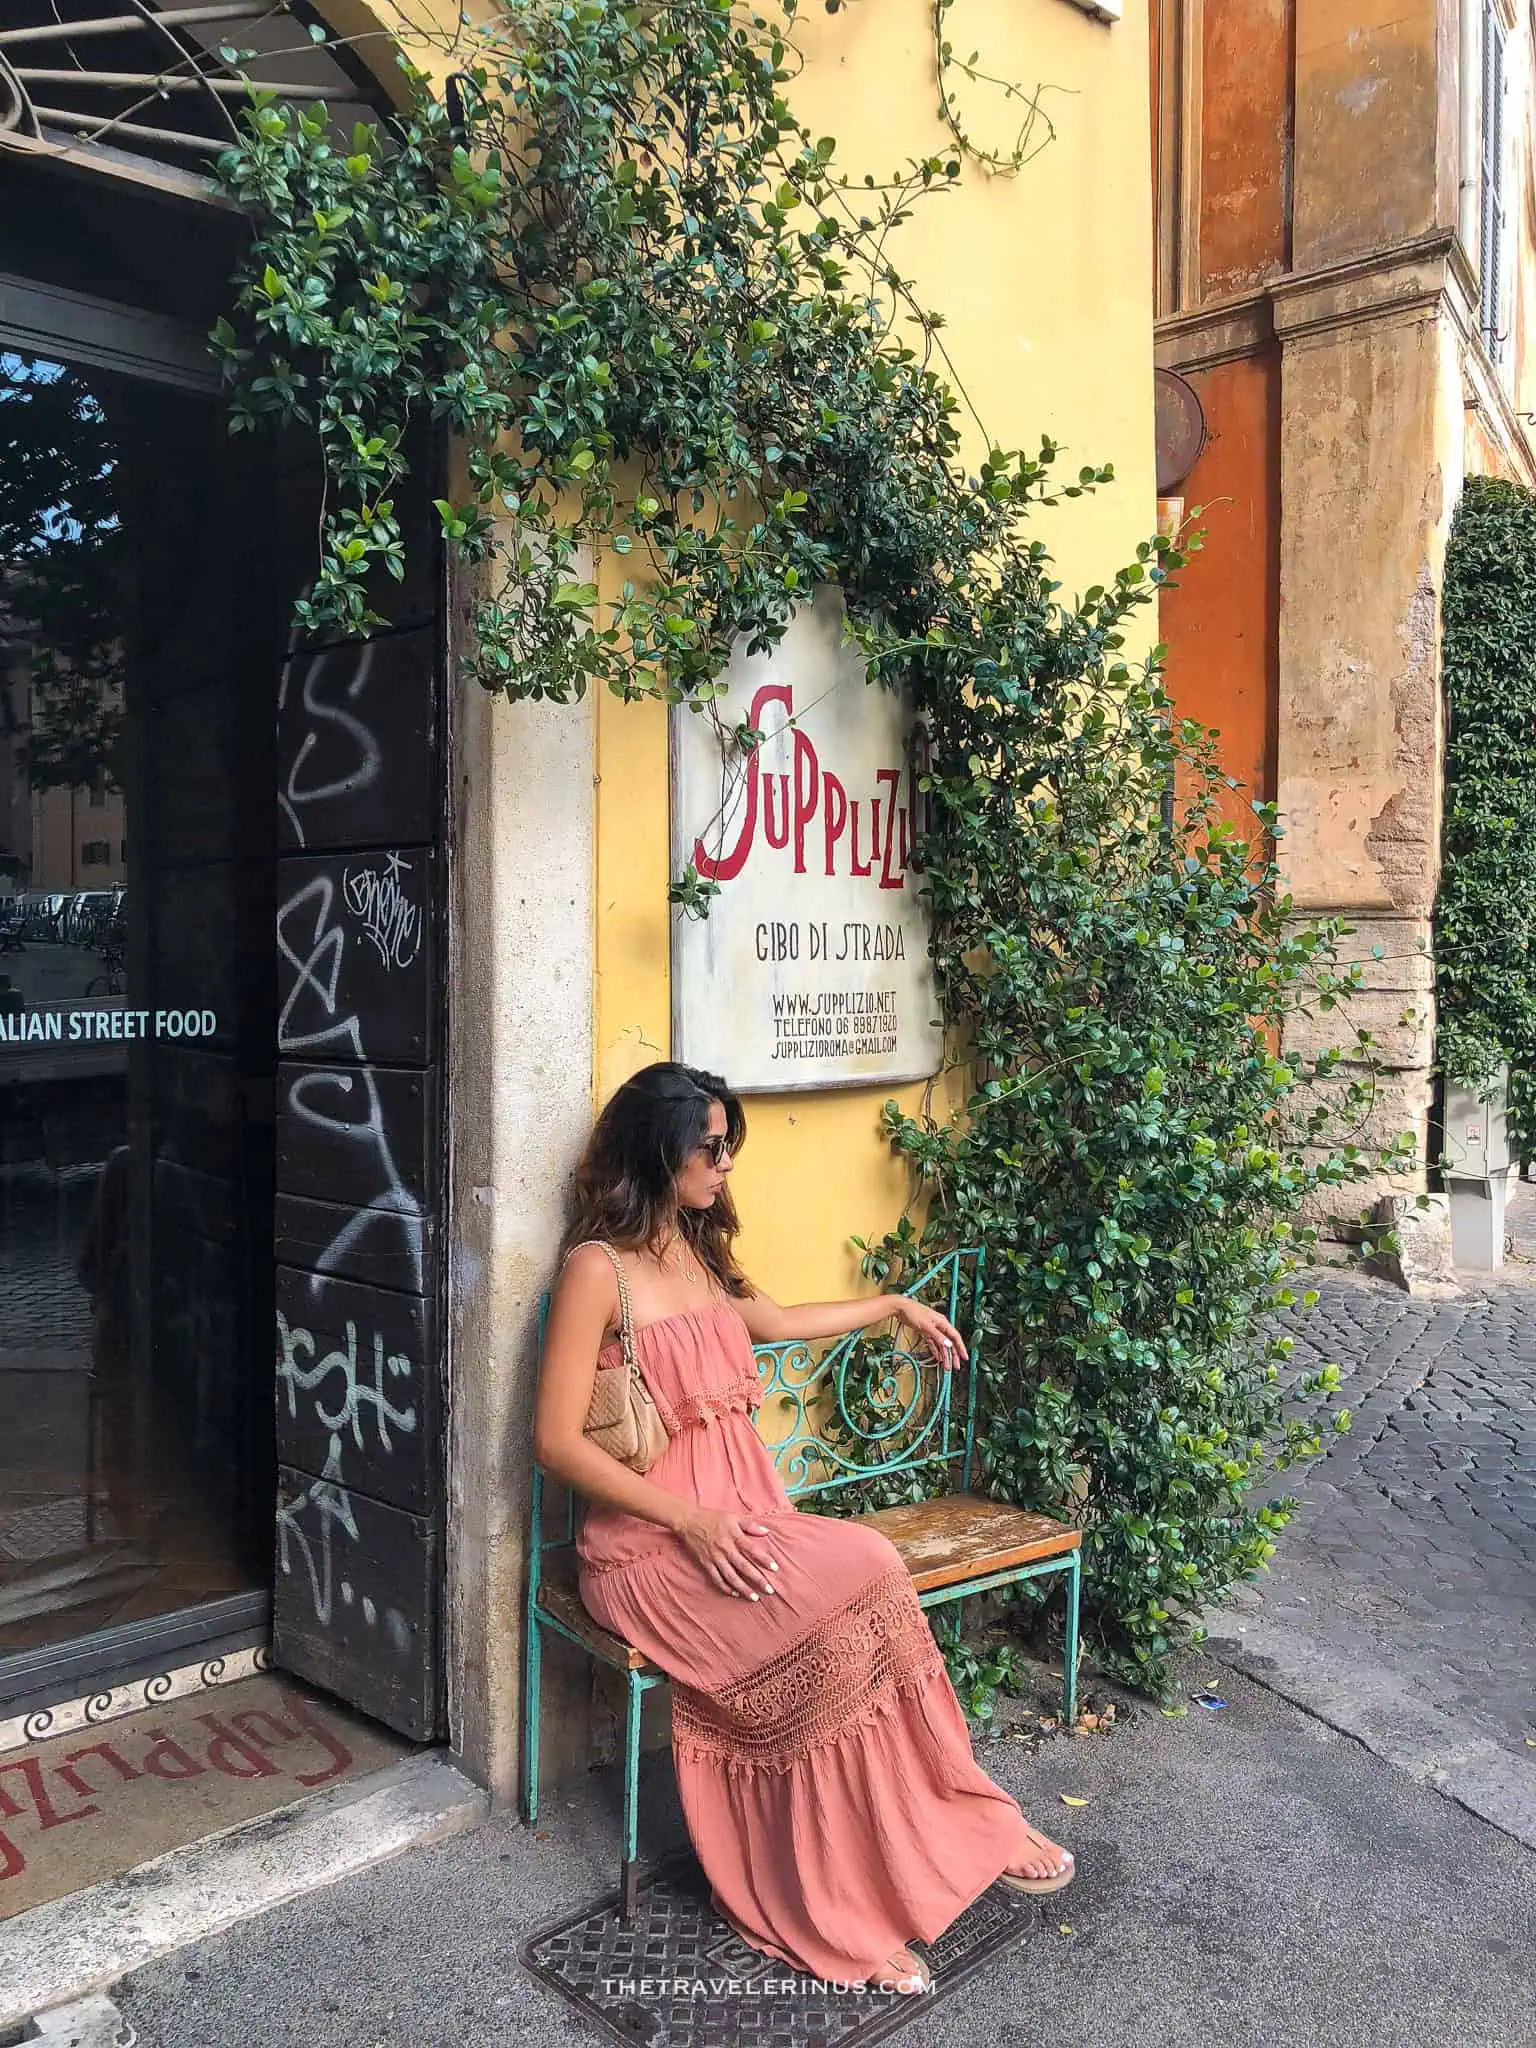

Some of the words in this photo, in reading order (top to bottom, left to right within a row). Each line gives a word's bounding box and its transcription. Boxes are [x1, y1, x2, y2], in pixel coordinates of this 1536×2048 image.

[755, 922, 799, 961] CIBO
[808, 922, 828, 961] DI
[836, 922, 905, 961] STRADA
[772, 991, 897, 1017] WWW.SUPPLIZIO.NET
[68, 1011, 150, 1040] STREET
[155, 1009, 217, 1038] FOOD
[773, 1017, 832, 1038] TELEFONO
[836, 1016, 849, 1035] 06
